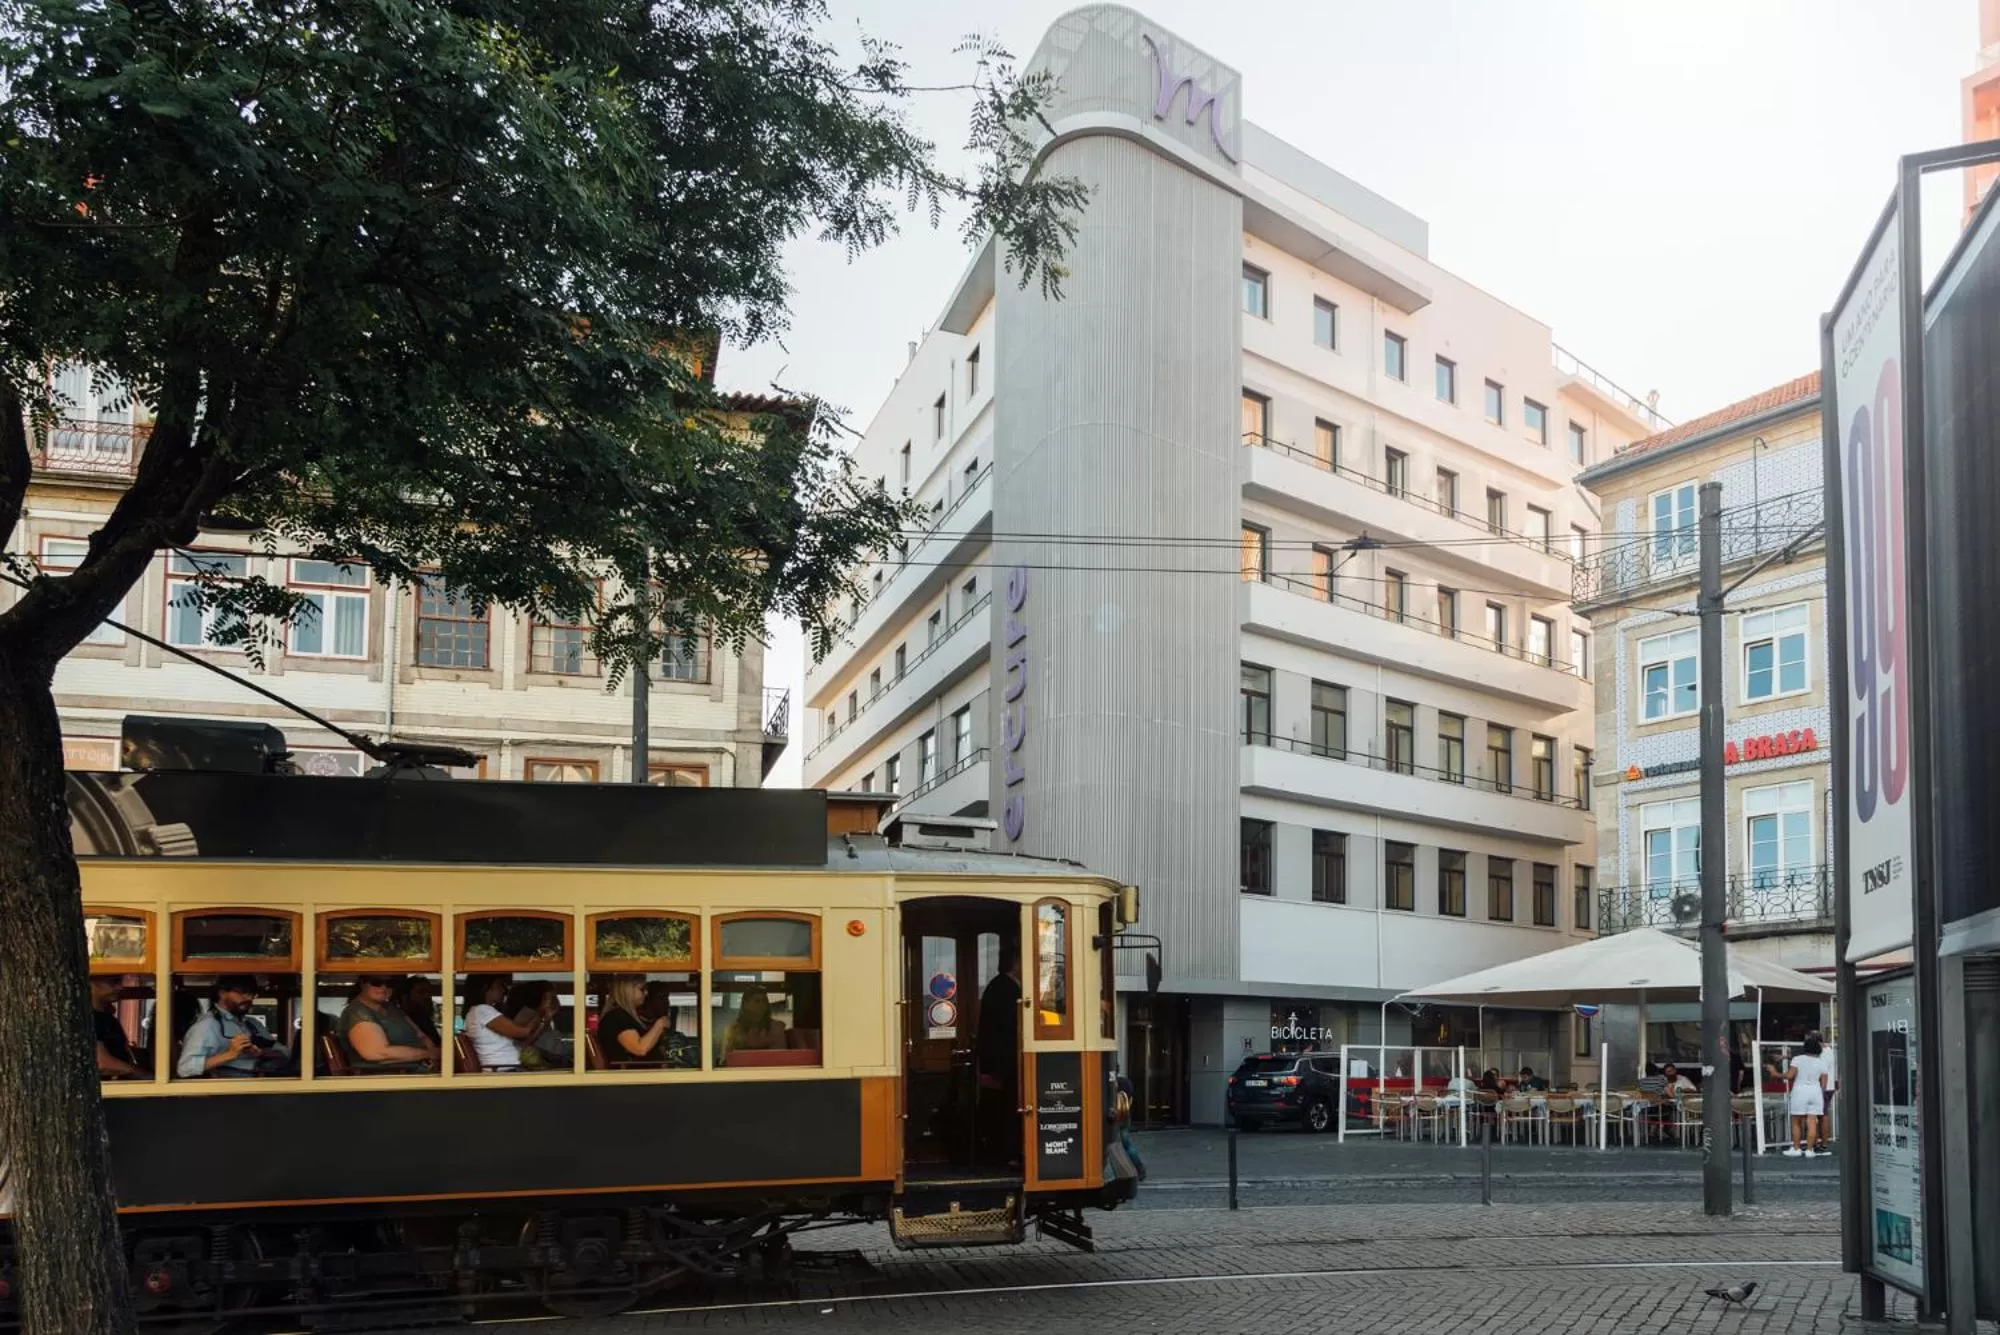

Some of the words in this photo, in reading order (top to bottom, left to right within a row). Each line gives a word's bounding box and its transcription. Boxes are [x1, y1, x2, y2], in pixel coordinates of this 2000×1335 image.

[1847, 357, 1909, 824] 99
[1724, 742, 1738, 766] A
[1743, 727, 1817, 761] BRASA
[1271, 1026, 1333, 1040] BICICLETA
[1045, 1141, 1068, 1149] MONT
[1045, 1147, 1068, 1155] BLANC
